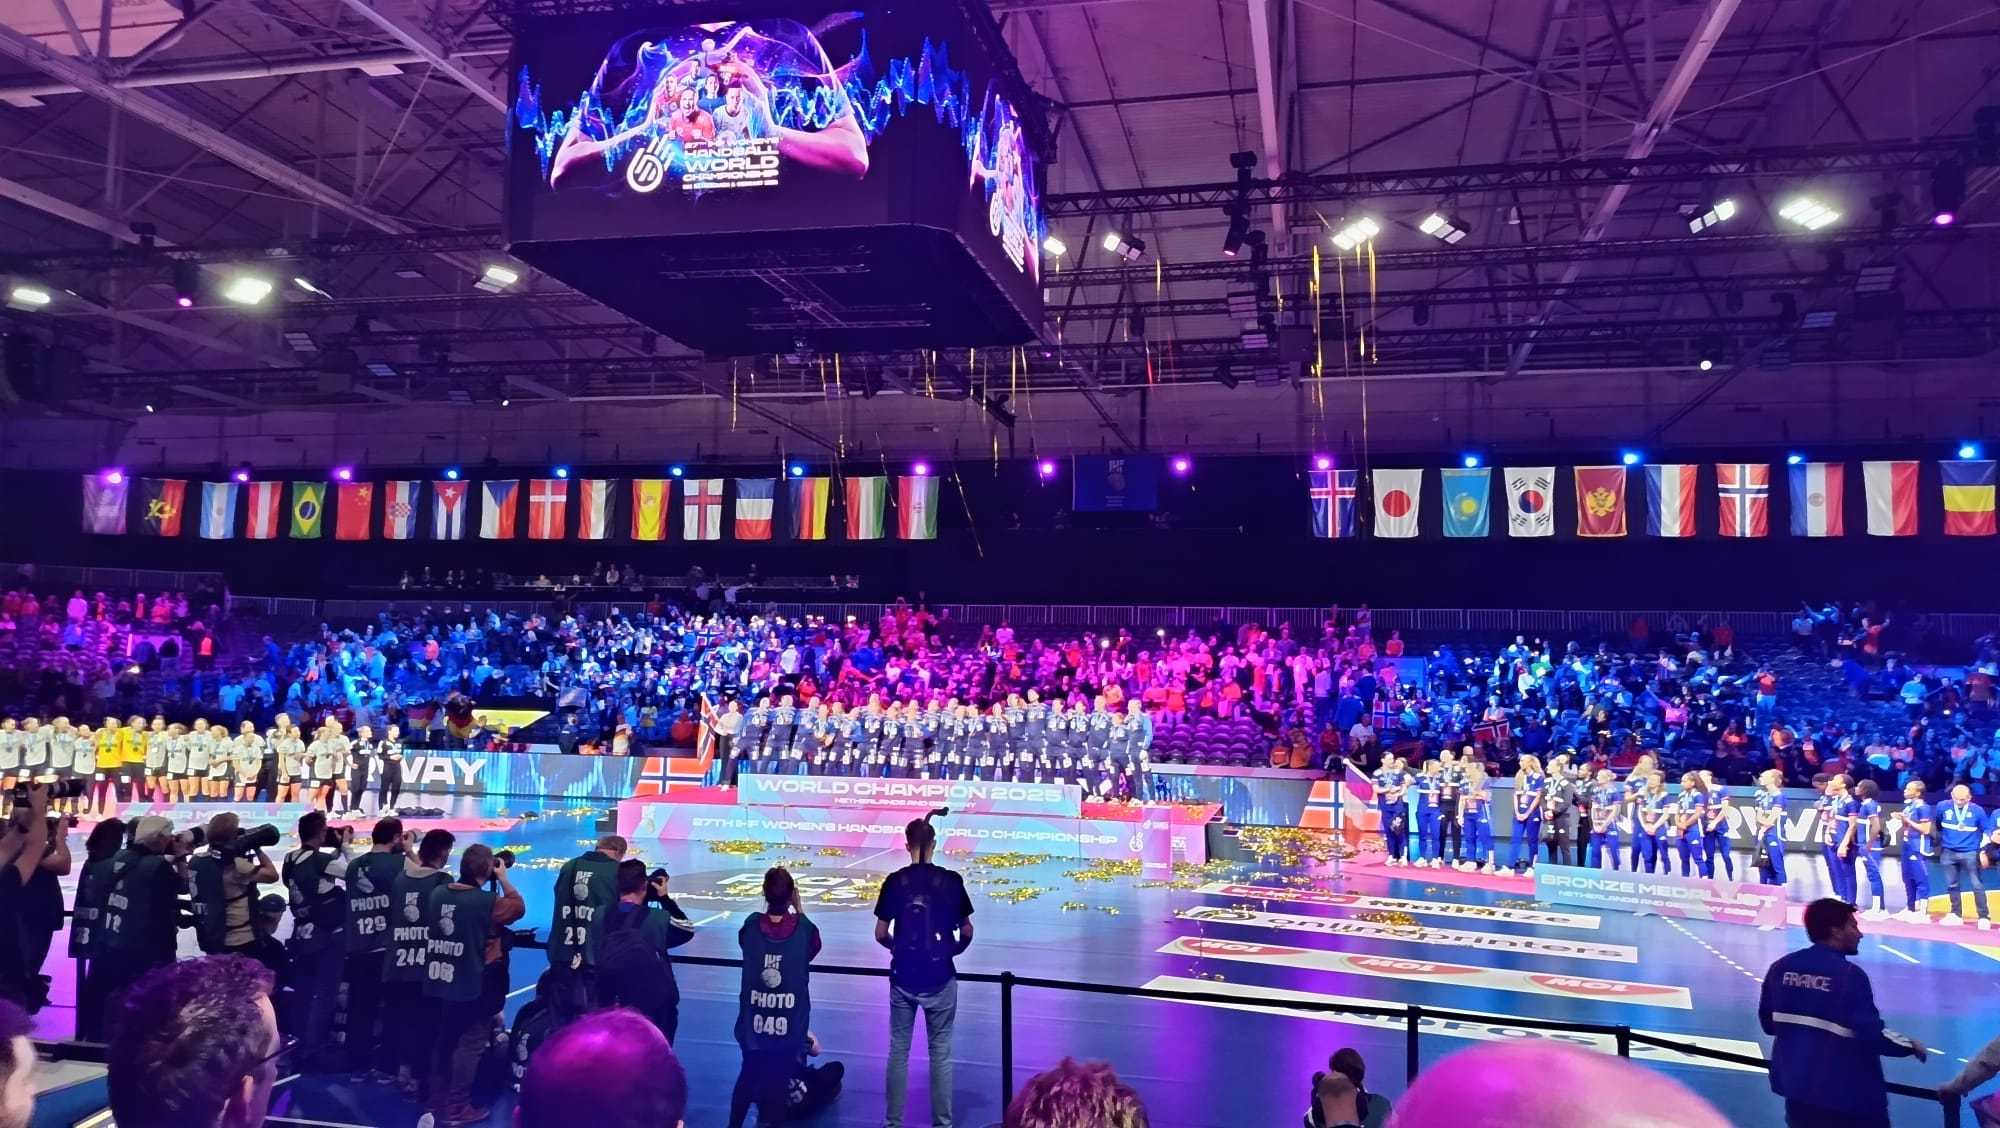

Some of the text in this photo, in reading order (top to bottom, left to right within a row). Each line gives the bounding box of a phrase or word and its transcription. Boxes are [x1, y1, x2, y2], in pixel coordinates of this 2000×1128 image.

[684, 155, 780, 173] WORLD
[756, 779, 1063, 802] WORLD CHAMPION 2025
[691, 817, 734, 828] 27TH
[760, 819, 836, 832] WOMEN'S
[837, 823, 906, 834] HANDBA
[991, 829, 1119, 845] CHAMPIONSHIP
[1540, 873, 1635, 893] BRONZE
[351, 894, 390, 912] PHOTO
[1557, 889, 1640, 905] NETHERLANDS
[357, 915, 387, 935] 129
[427, 939, 464, 957] PHOTO
[1193, 940, 1265, 953] MOL
[395, 948, 426, 967] 244
[763, 953, 783, 970] IHF
[1359, 958, 1436, 972] MOL
[1545, 976, 1629, 992] MOL
[1782, 971, 1832, 993] FRANCE
[750, 989, 795, 1009] PHOTO
[753, 1014, 788, 1036] 049
